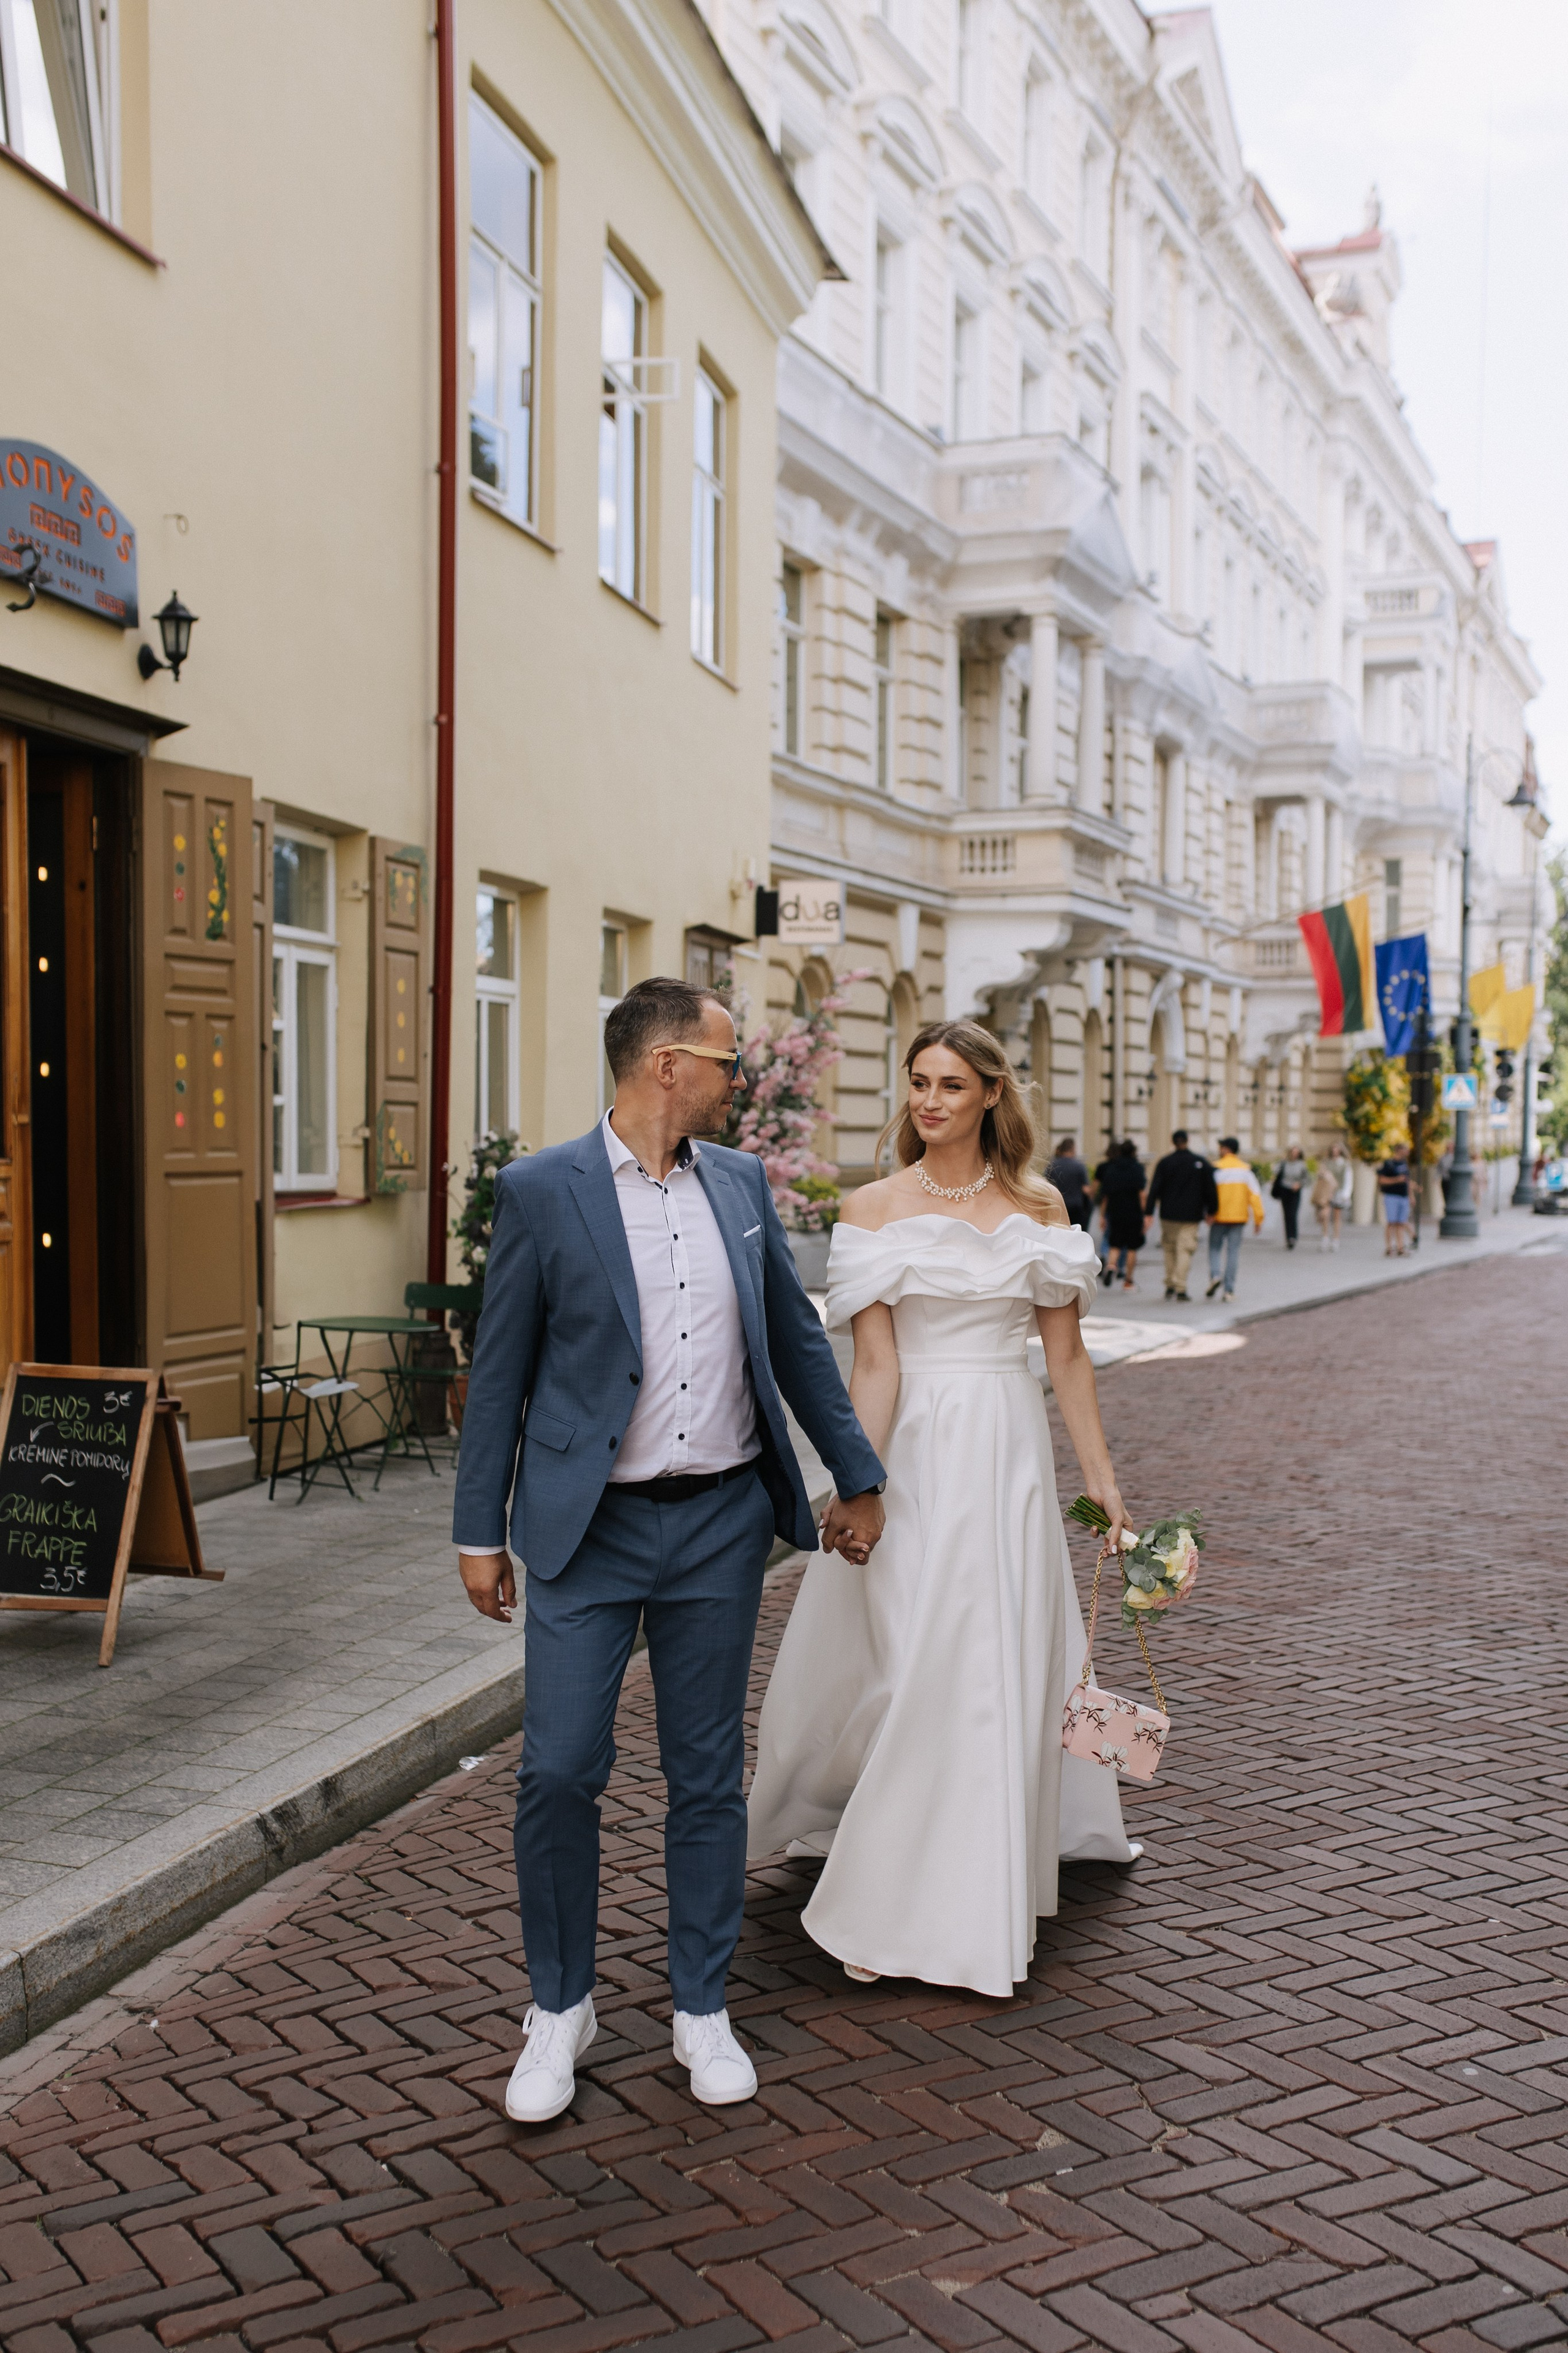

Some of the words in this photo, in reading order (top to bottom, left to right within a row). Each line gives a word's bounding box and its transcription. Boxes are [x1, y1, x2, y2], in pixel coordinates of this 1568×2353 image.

[780, 894, 840, 921] dua
[22, 1394, 90, 1420] DIENOS
[58, 1420, 126, 1446] SRIUBA
